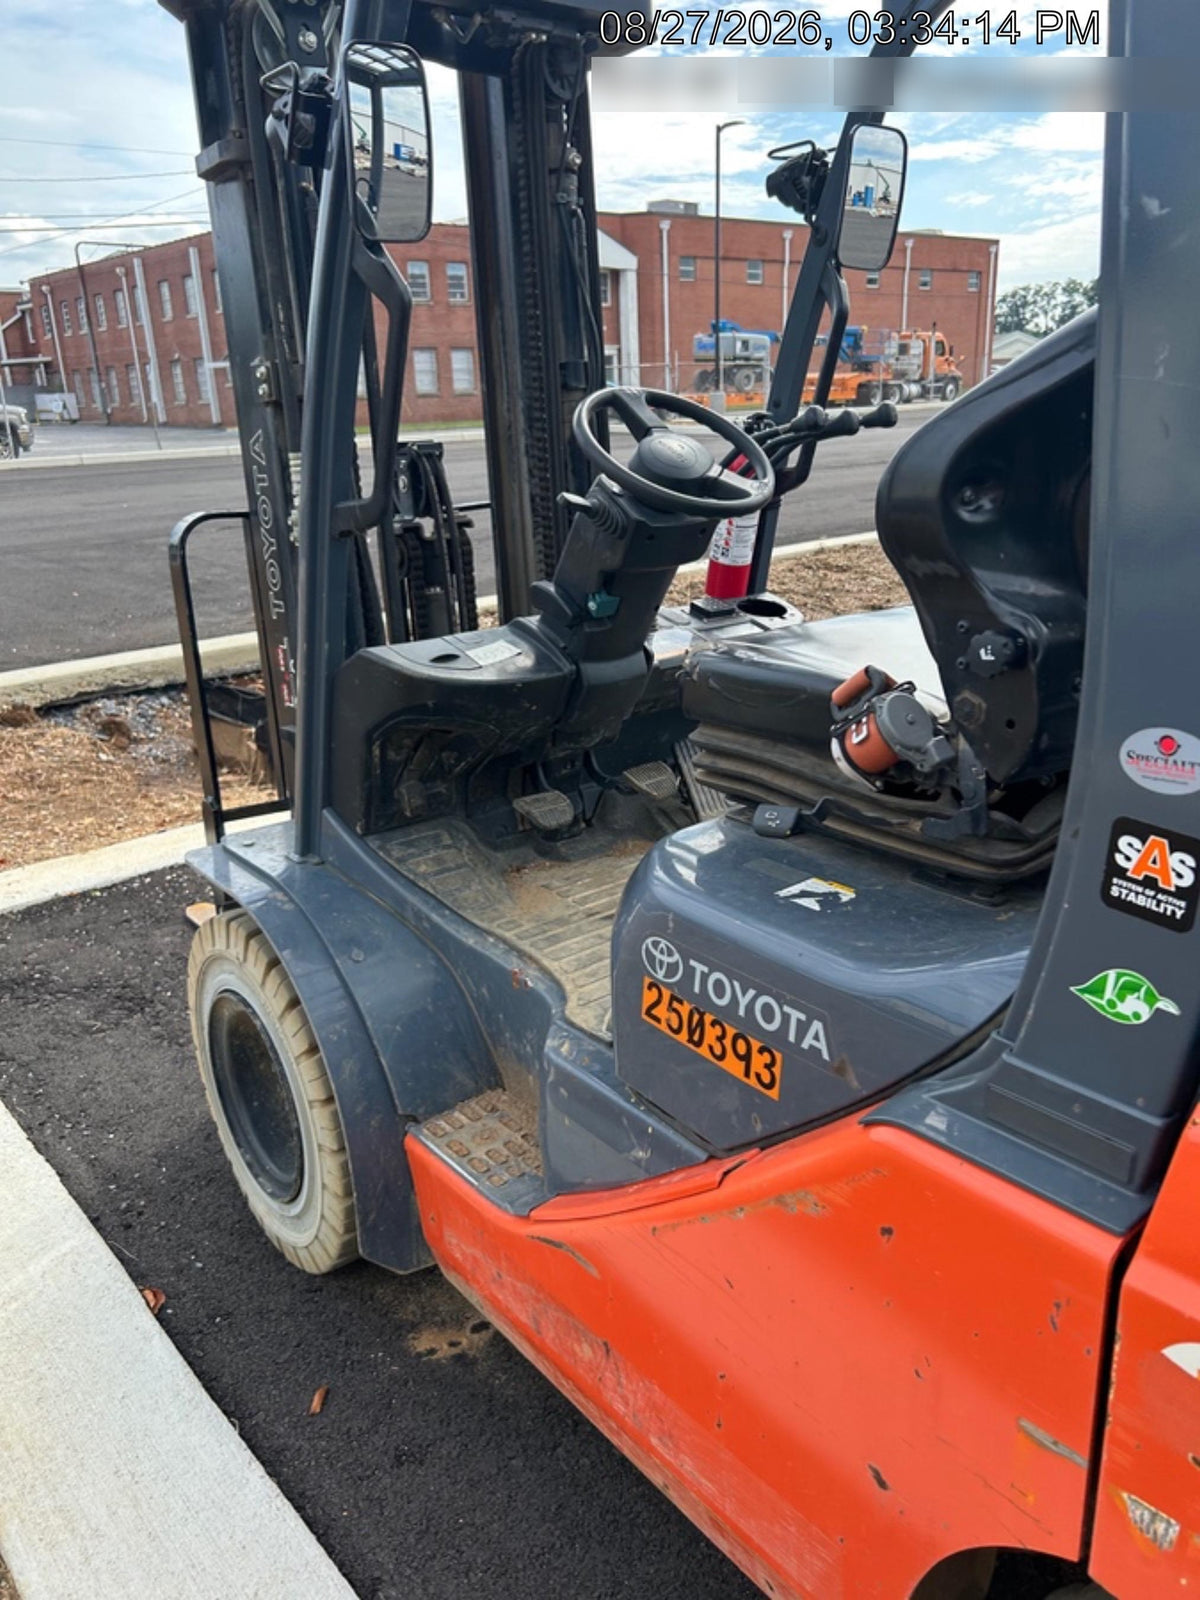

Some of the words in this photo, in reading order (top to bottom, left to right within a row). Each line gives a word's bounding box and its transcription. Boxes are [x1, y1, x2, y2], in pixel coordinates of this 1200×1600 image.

[249, 429, 285, 620] TOYOTA
[1109, 885, 1187, 920] STABILITY
[1114, 834, 1197, 892] SAS
[644, 980, 778, 1091] 250393
[689, 959, 830, 1062] TOYOTA
